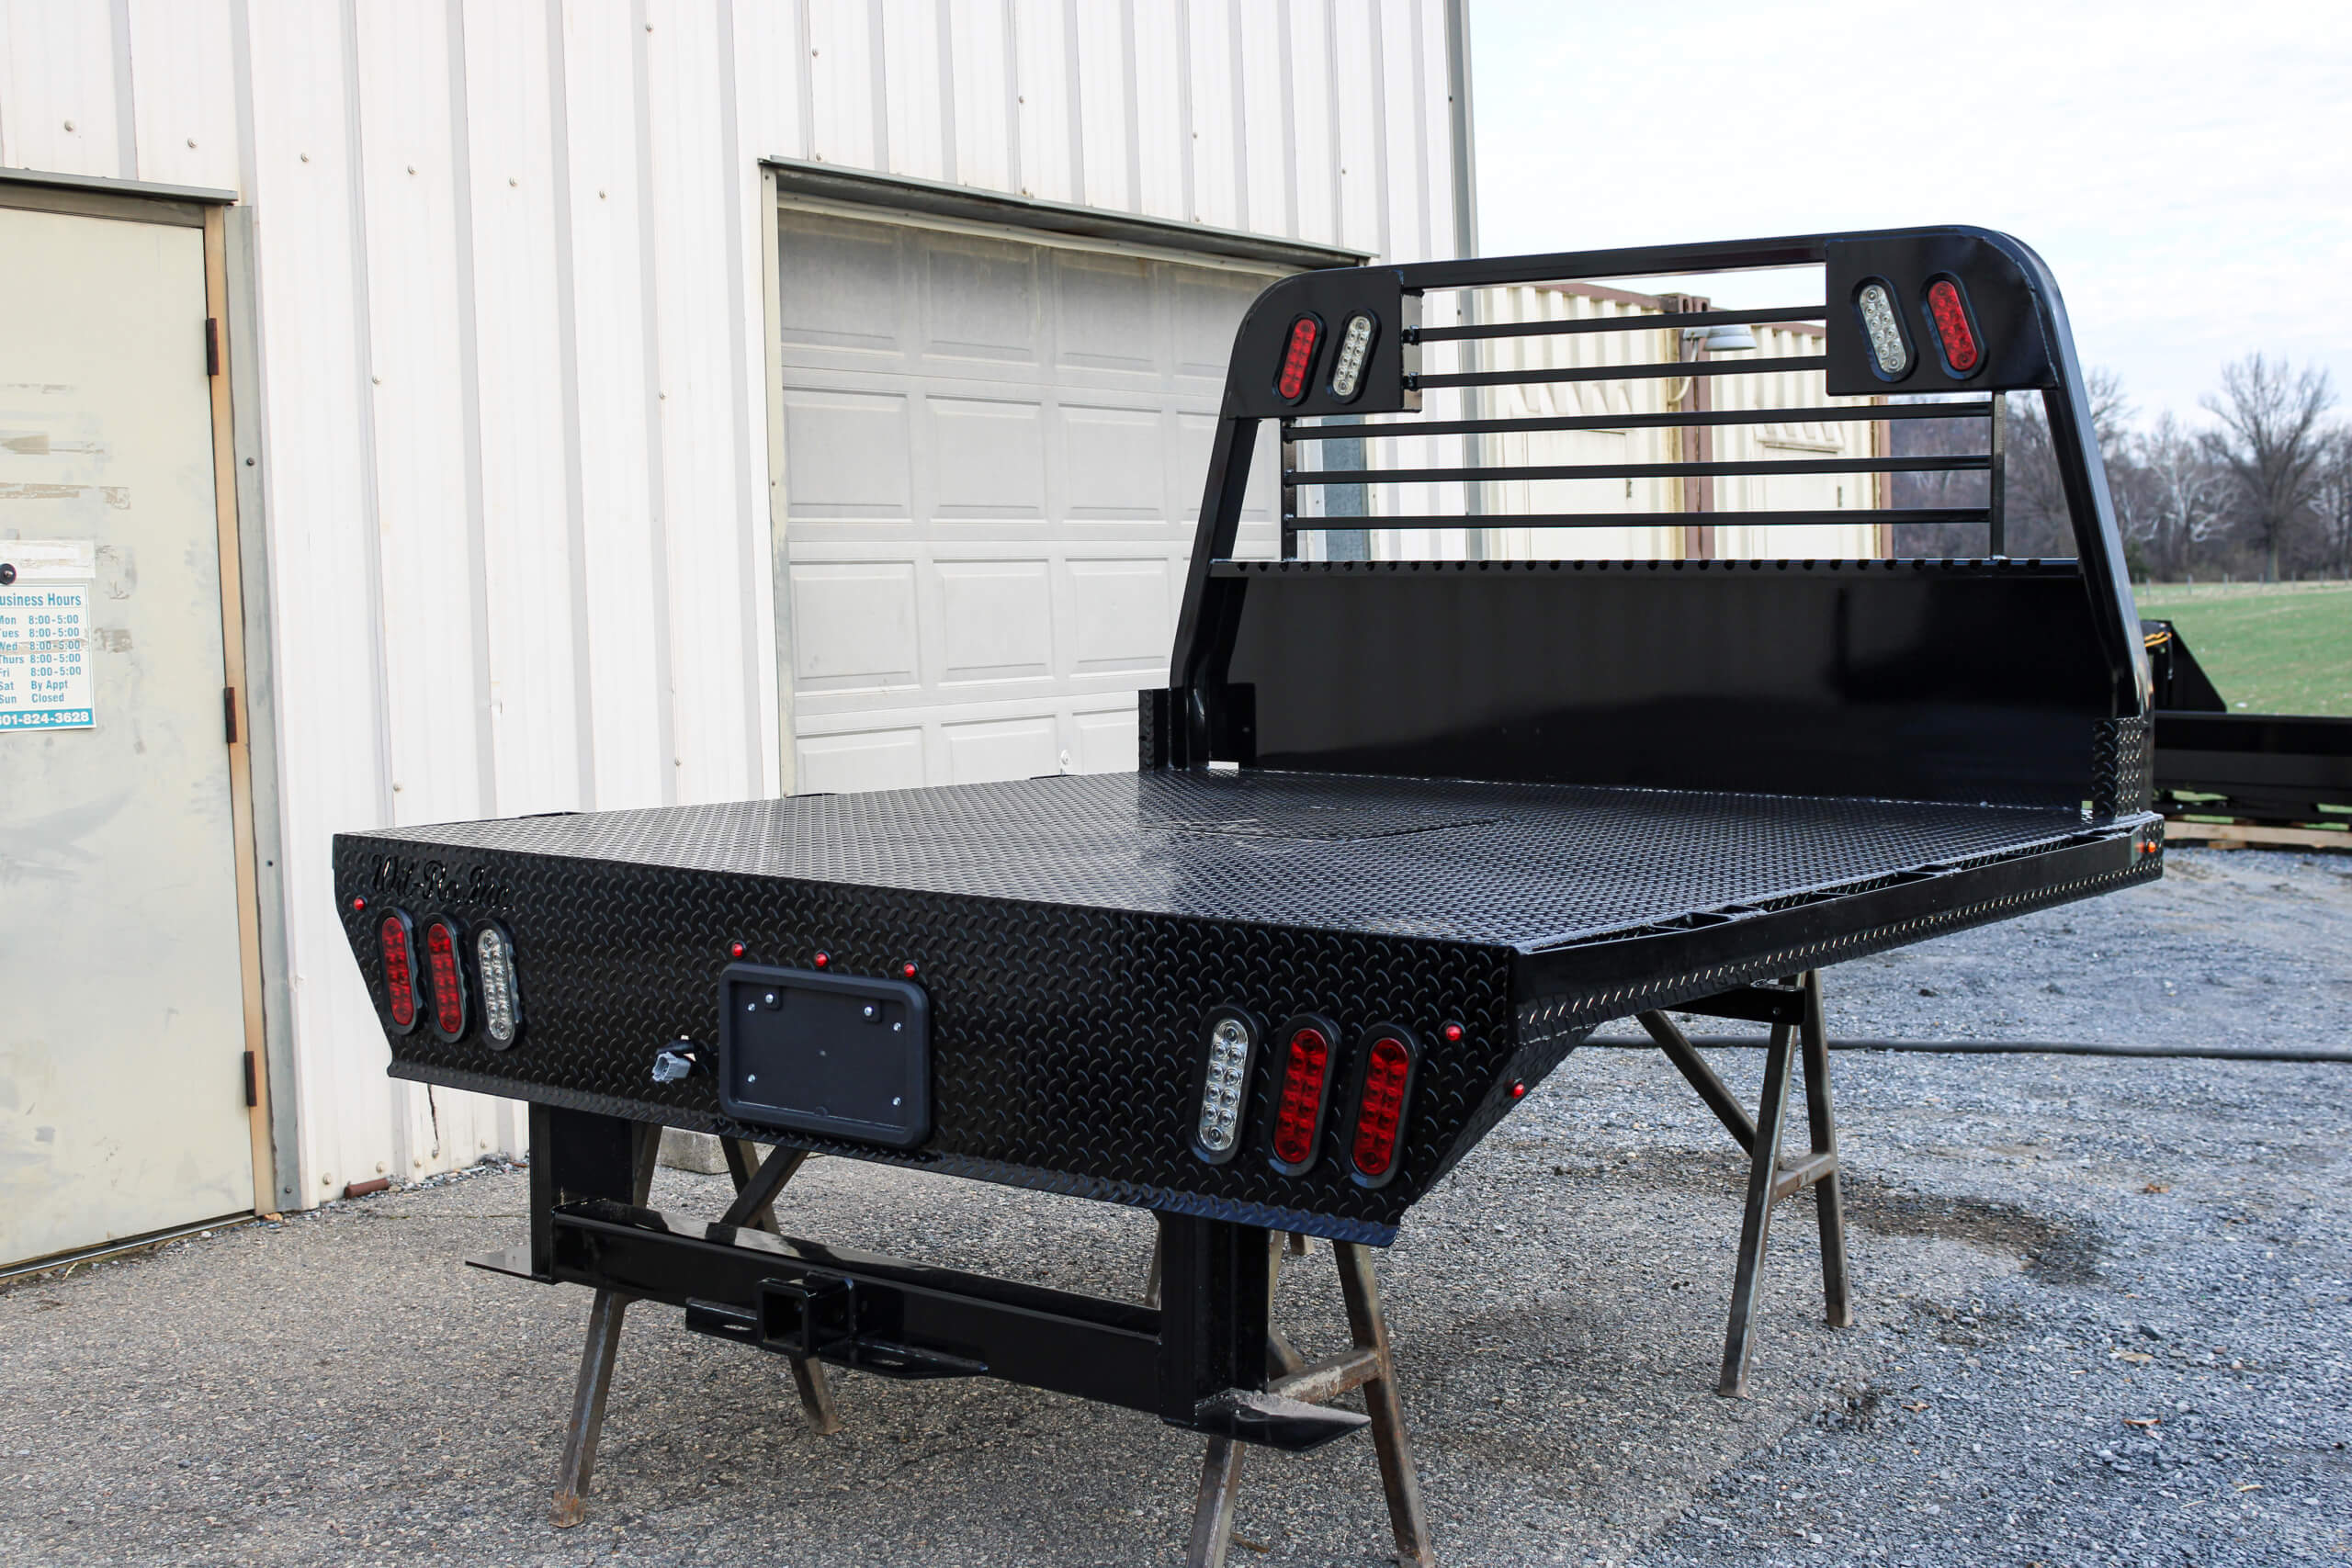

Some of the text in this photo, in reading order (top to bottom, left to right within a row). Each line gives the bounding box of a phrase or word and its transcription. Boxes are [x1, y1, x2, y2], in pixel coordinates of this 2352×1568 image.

[0, 592, 82, 606] usiness Hours
[0, 680, 68, 691] Sat By Appt
[0, 693, 64, 704] Sun Closed
